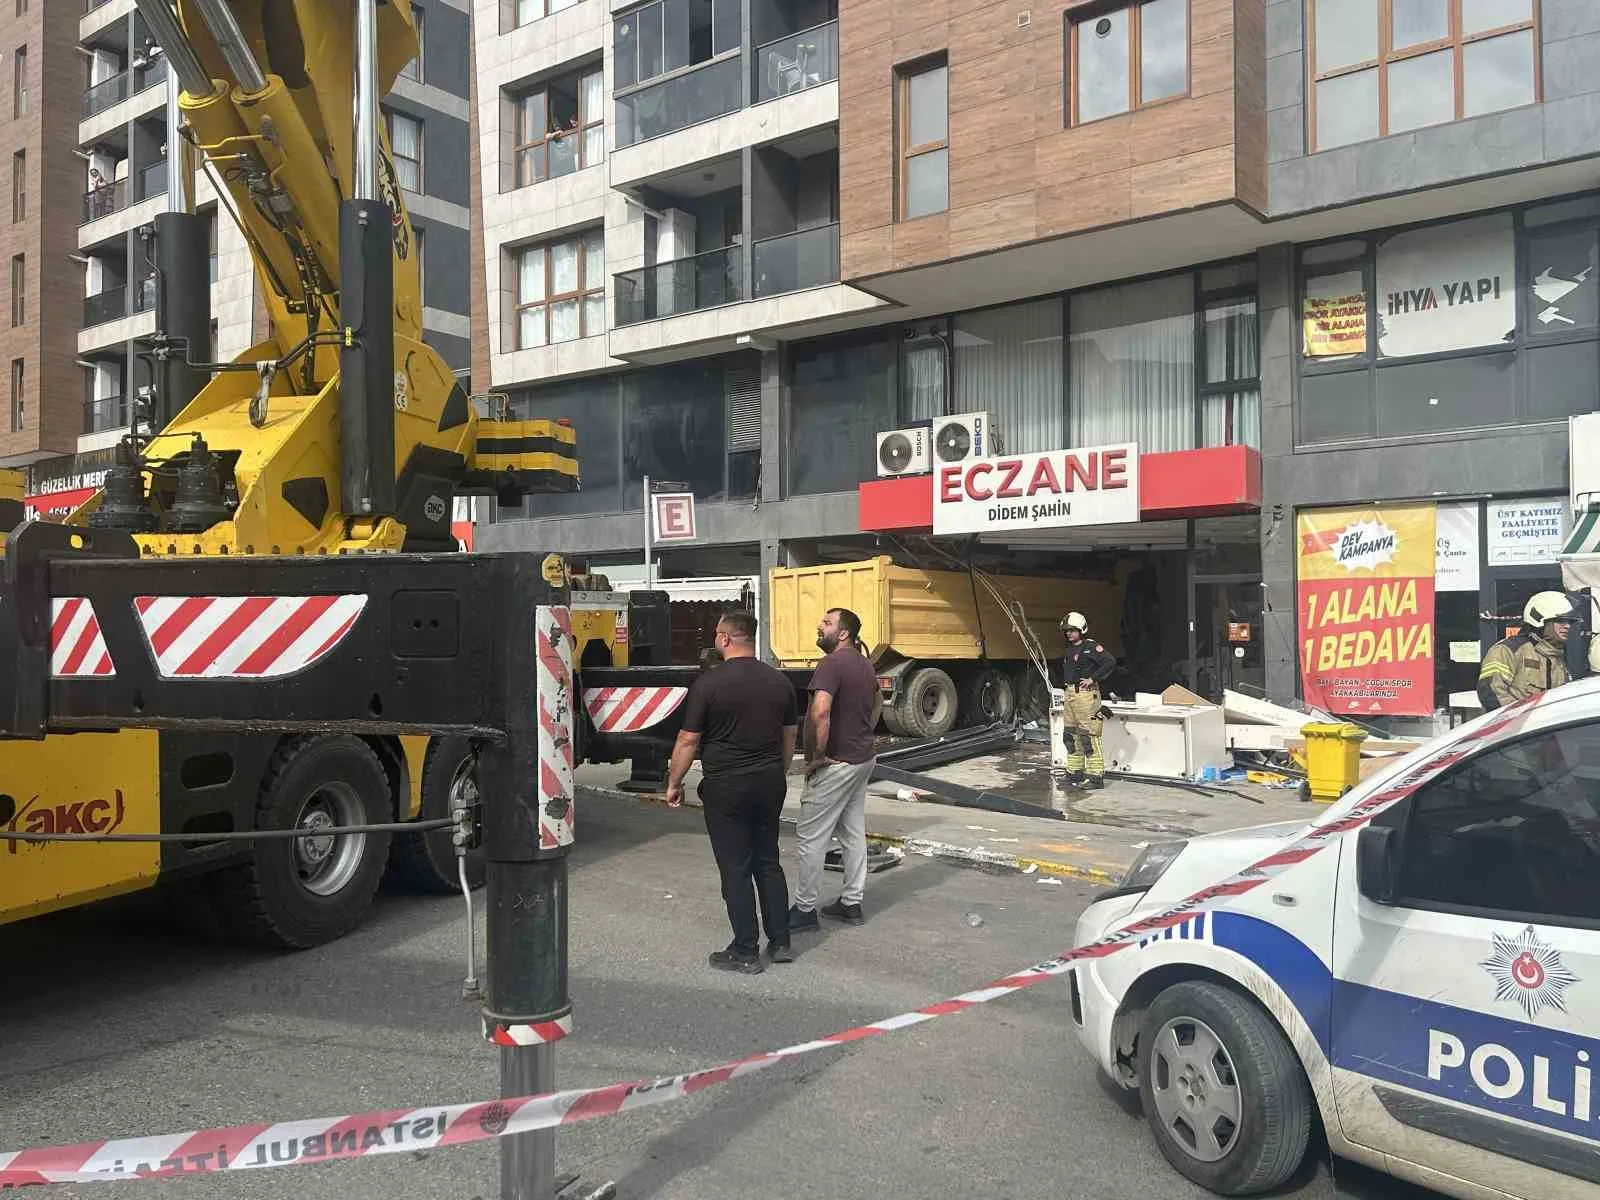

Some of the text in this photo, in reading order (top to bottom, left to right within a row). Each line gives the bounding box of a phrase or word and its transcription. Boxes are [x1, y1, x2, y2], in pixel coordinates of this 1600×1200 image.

[1443, 276, 1500, 306] YAPI
[41, 474, 82, 495] GÜZELLİK
[940, 448, 1128, 503] ECZANE
[665, 502, 685, 531] E
[988, 499, 1071, 521] DİDEM ŞAHİN
[1497, 508, 1516, 518] ÜST
[1502, 518, 1558, 528] FAALİYETE
[1342, 531, 1363, 547] DEV
[1501, 528, 1559, 538] GEÇMİŞTİR
[1340, 535, 1393, 561] KAMPANYA
[1306, 579, 1418, 630] 1 ALANA
[1304, 639, 1314, 673] 1
[1317, 623, 1432, 671] BEDAVA
[1428, 1029, 1600, 1121] POLİ
